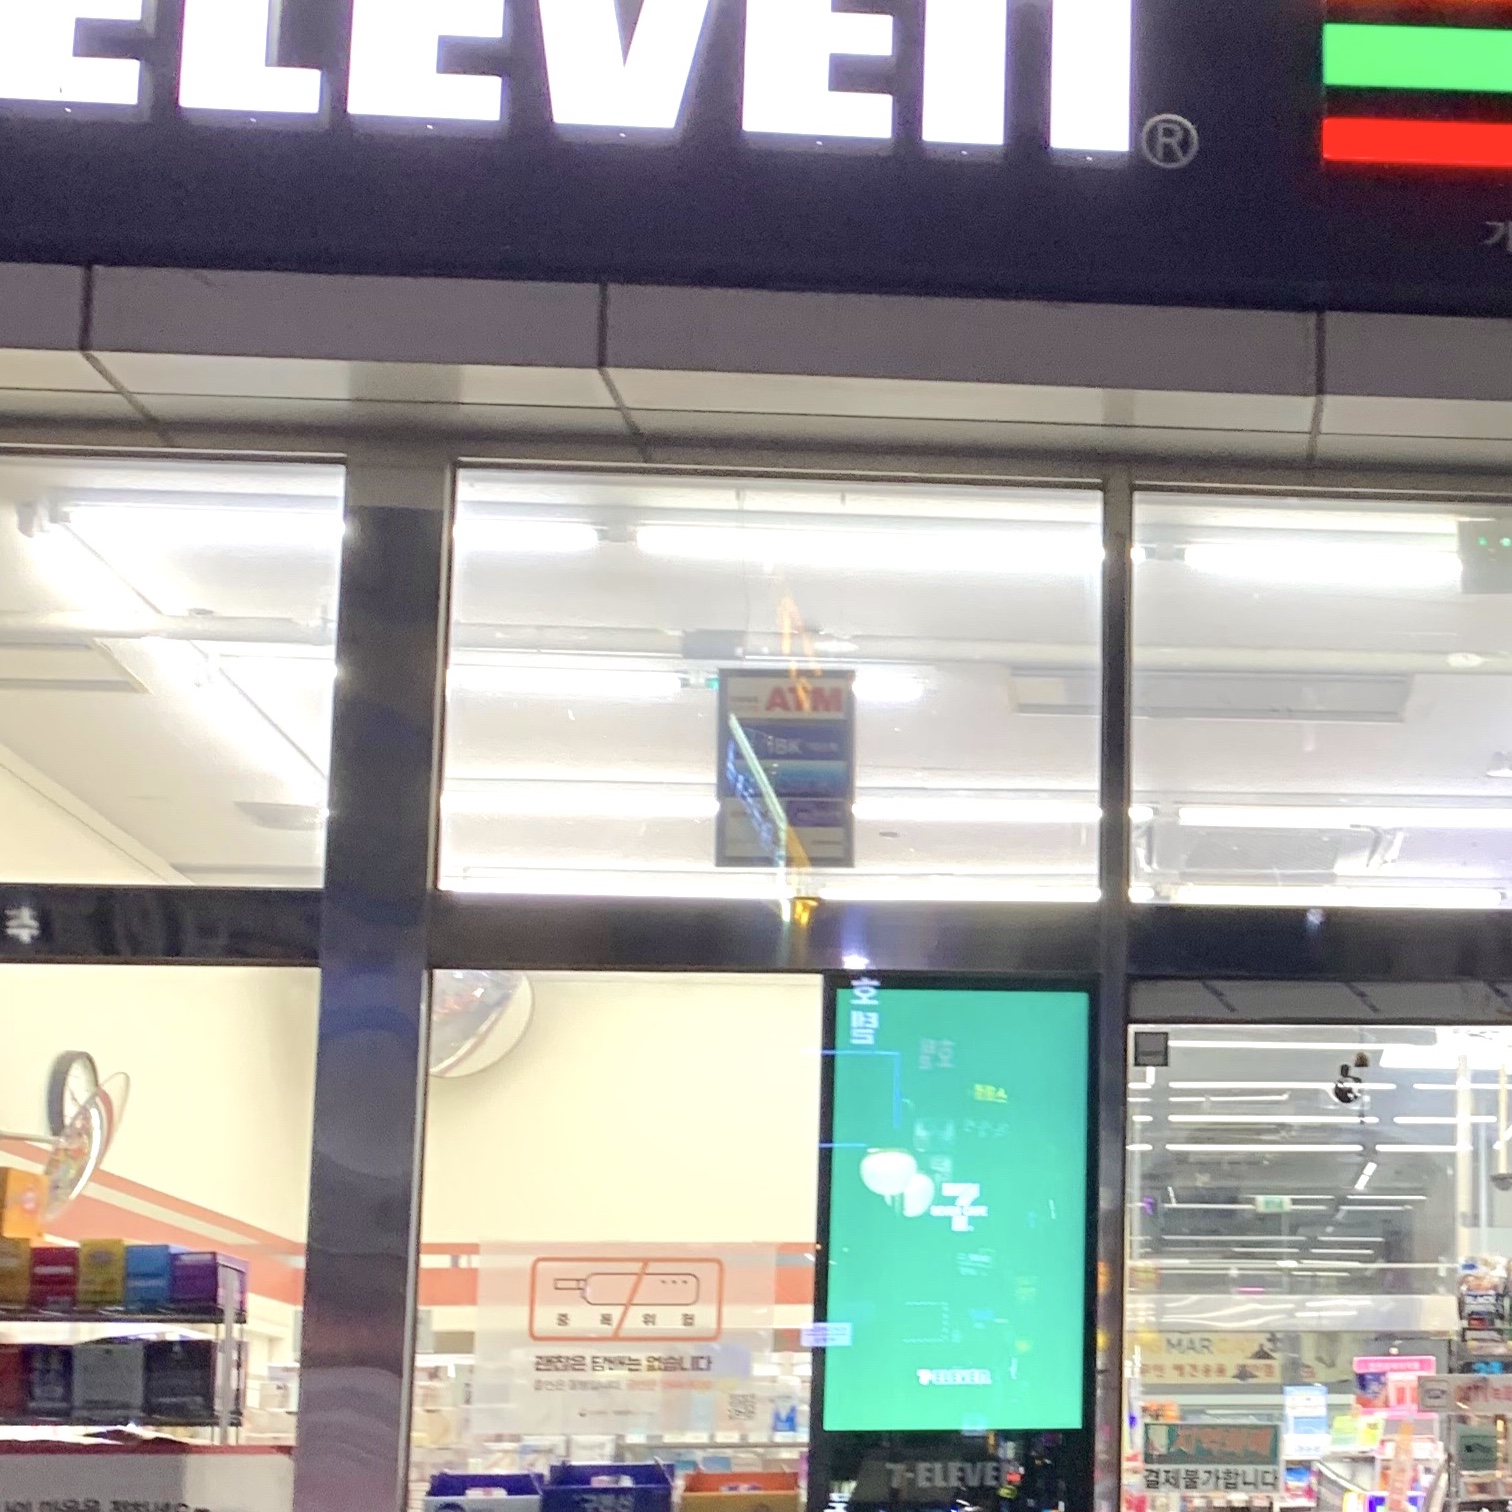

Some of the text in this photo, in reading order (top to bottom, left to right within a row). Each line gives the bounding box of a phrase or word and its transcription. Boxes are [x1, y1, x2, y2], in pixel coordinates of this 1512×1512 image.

[765, 686, 844, 713] ATM
[885, 1461, 1000, 1489] 7-ELEVE
[1144, 1467, 1279, 1491] 결제불가합니다
